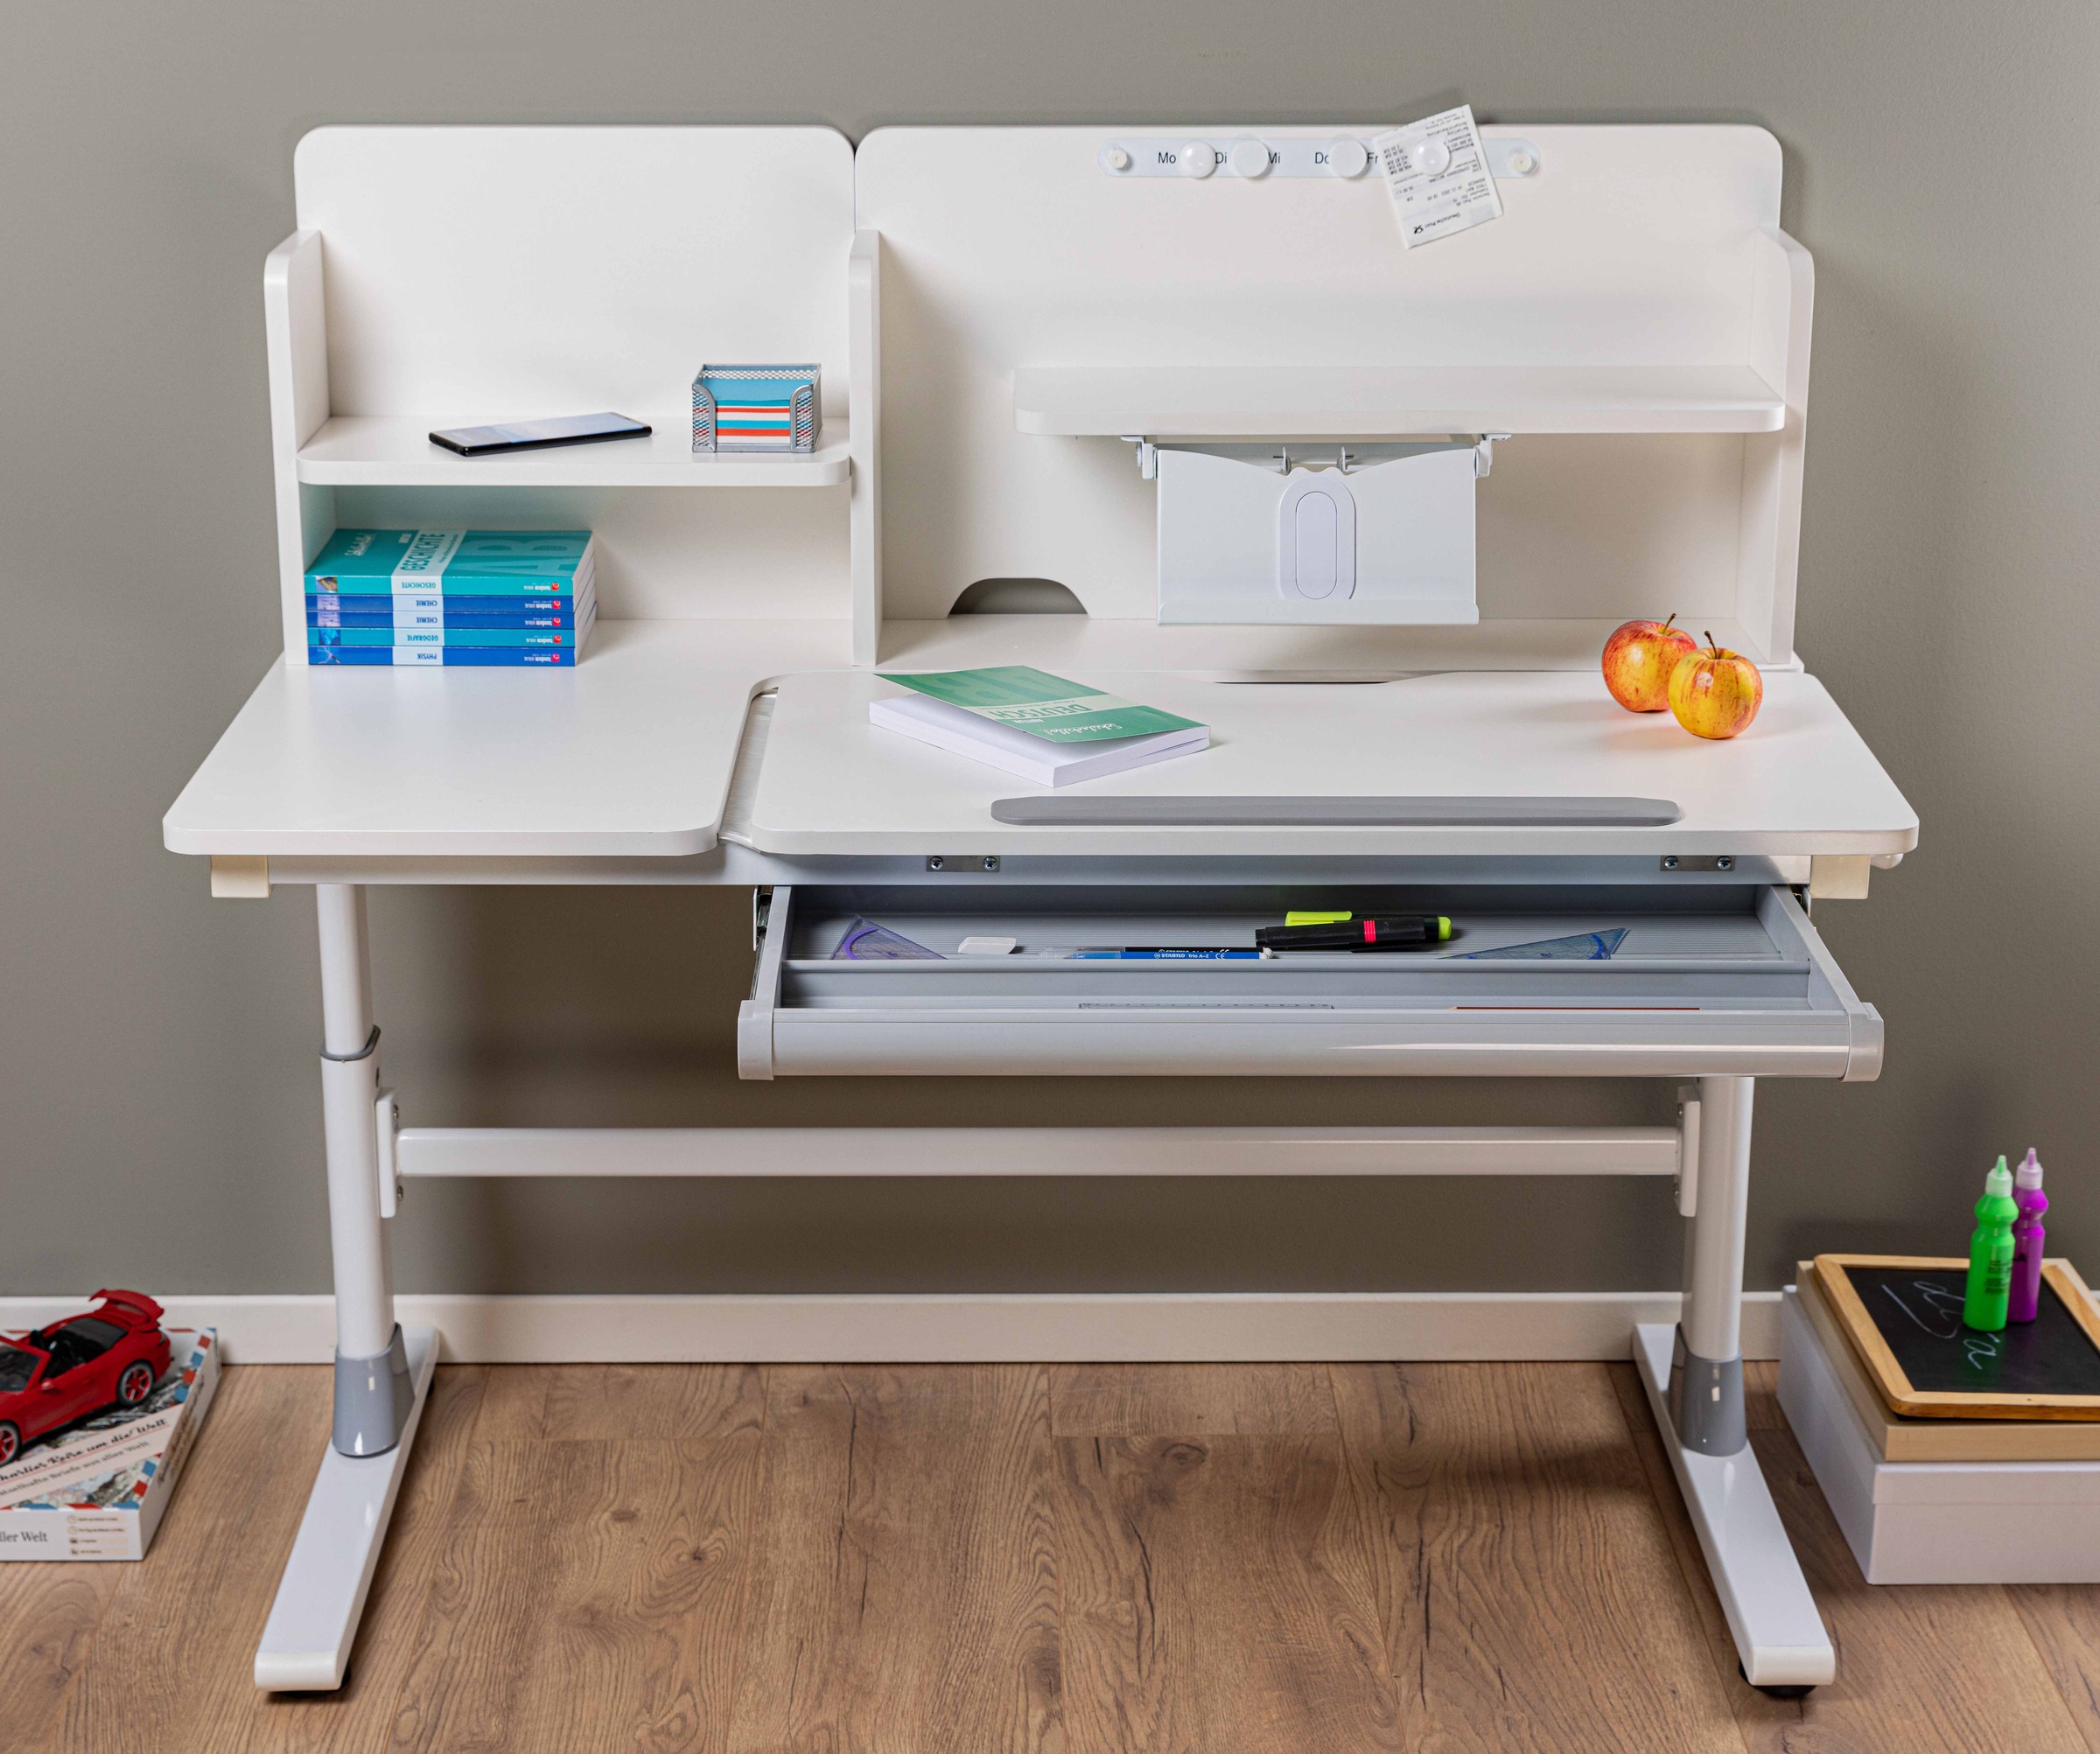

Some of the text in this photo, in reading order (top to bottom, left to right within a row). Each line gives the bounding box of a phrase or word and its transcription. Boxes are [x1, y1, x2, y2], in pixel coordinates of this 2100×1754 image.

[1158, 151, 1177, 164] Mo
[1215, 151, 1228, 164] Di
[1268, 151, 1281, 164] Mi
[1367, 151, 1379, 164] Fr
[399, 533, 445, 571] GESCHICHTE
[987, 703, 1095, 719] DEUTSCH
[0, 1531, 47, 1542] ller Welt
